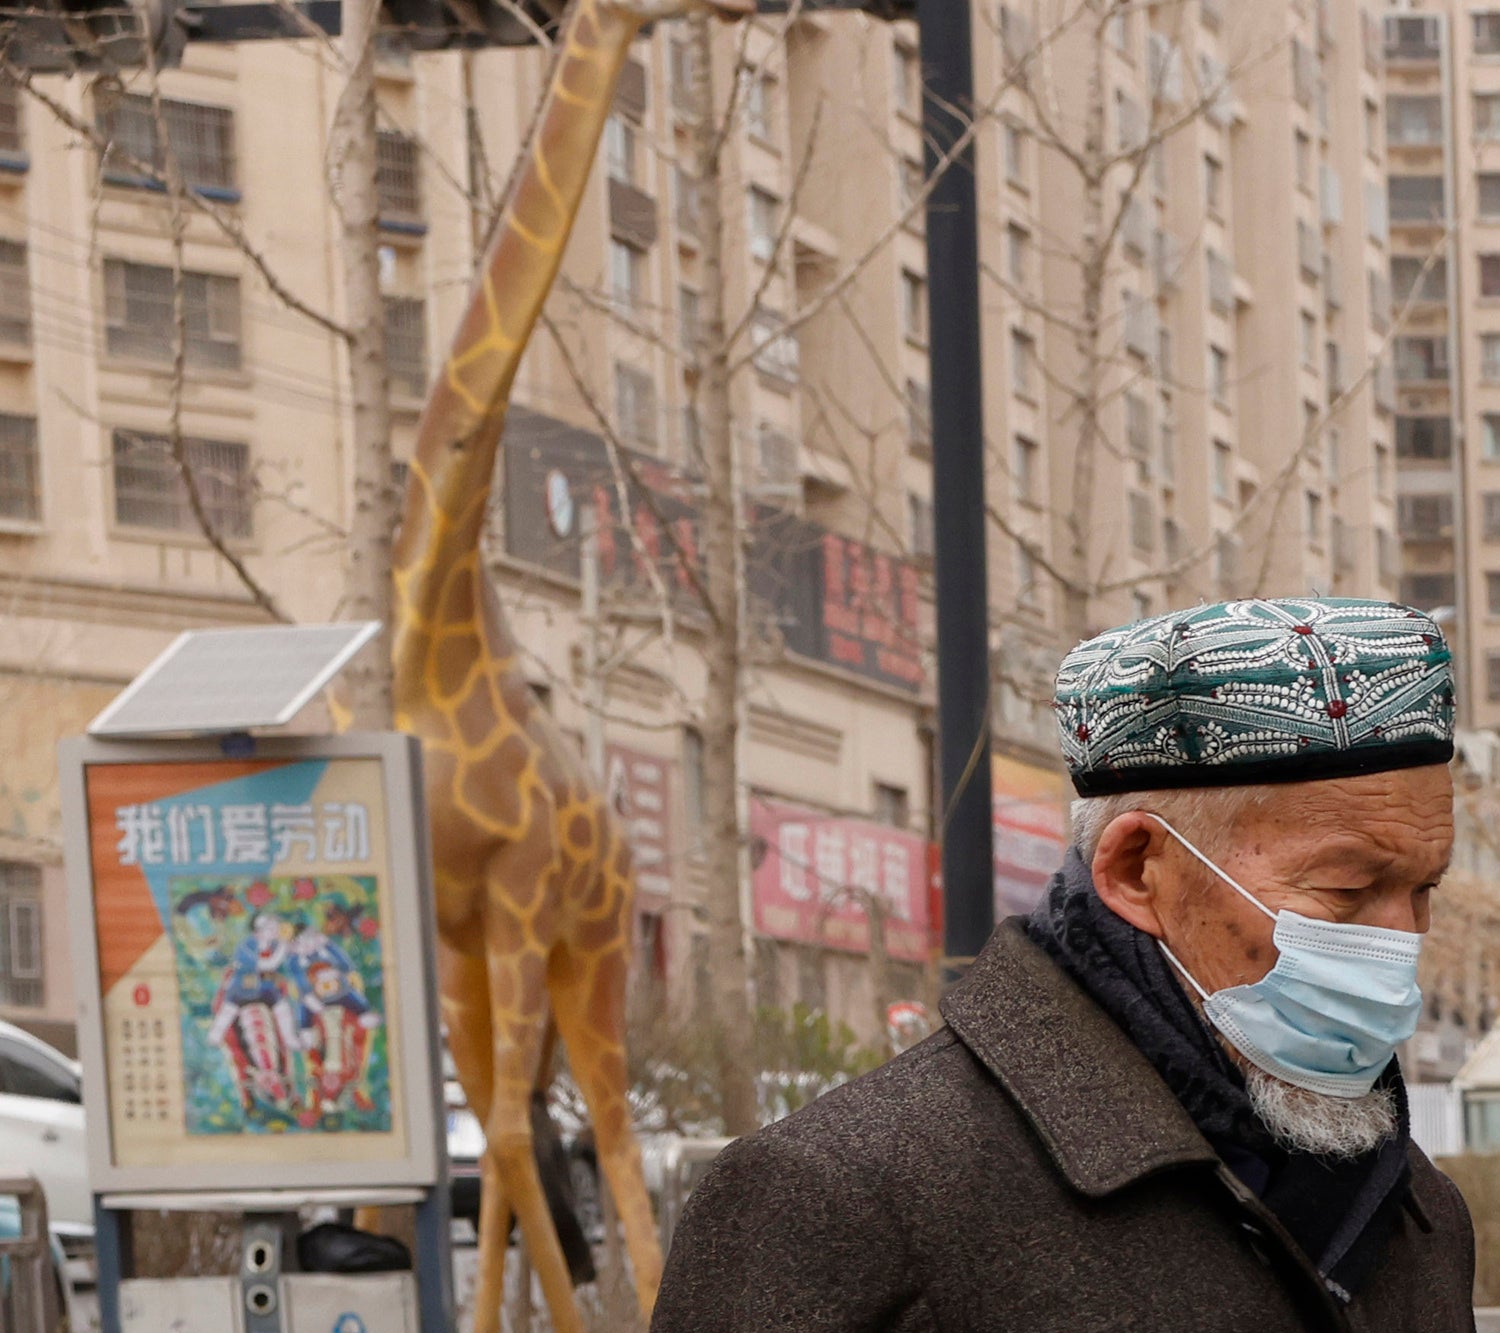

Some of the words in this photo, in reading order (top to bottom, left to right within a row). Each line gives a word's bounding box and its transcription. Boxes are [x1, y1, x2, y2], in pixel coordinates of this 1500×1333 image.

[114, 802, 371, 867] 我们爱劳动
